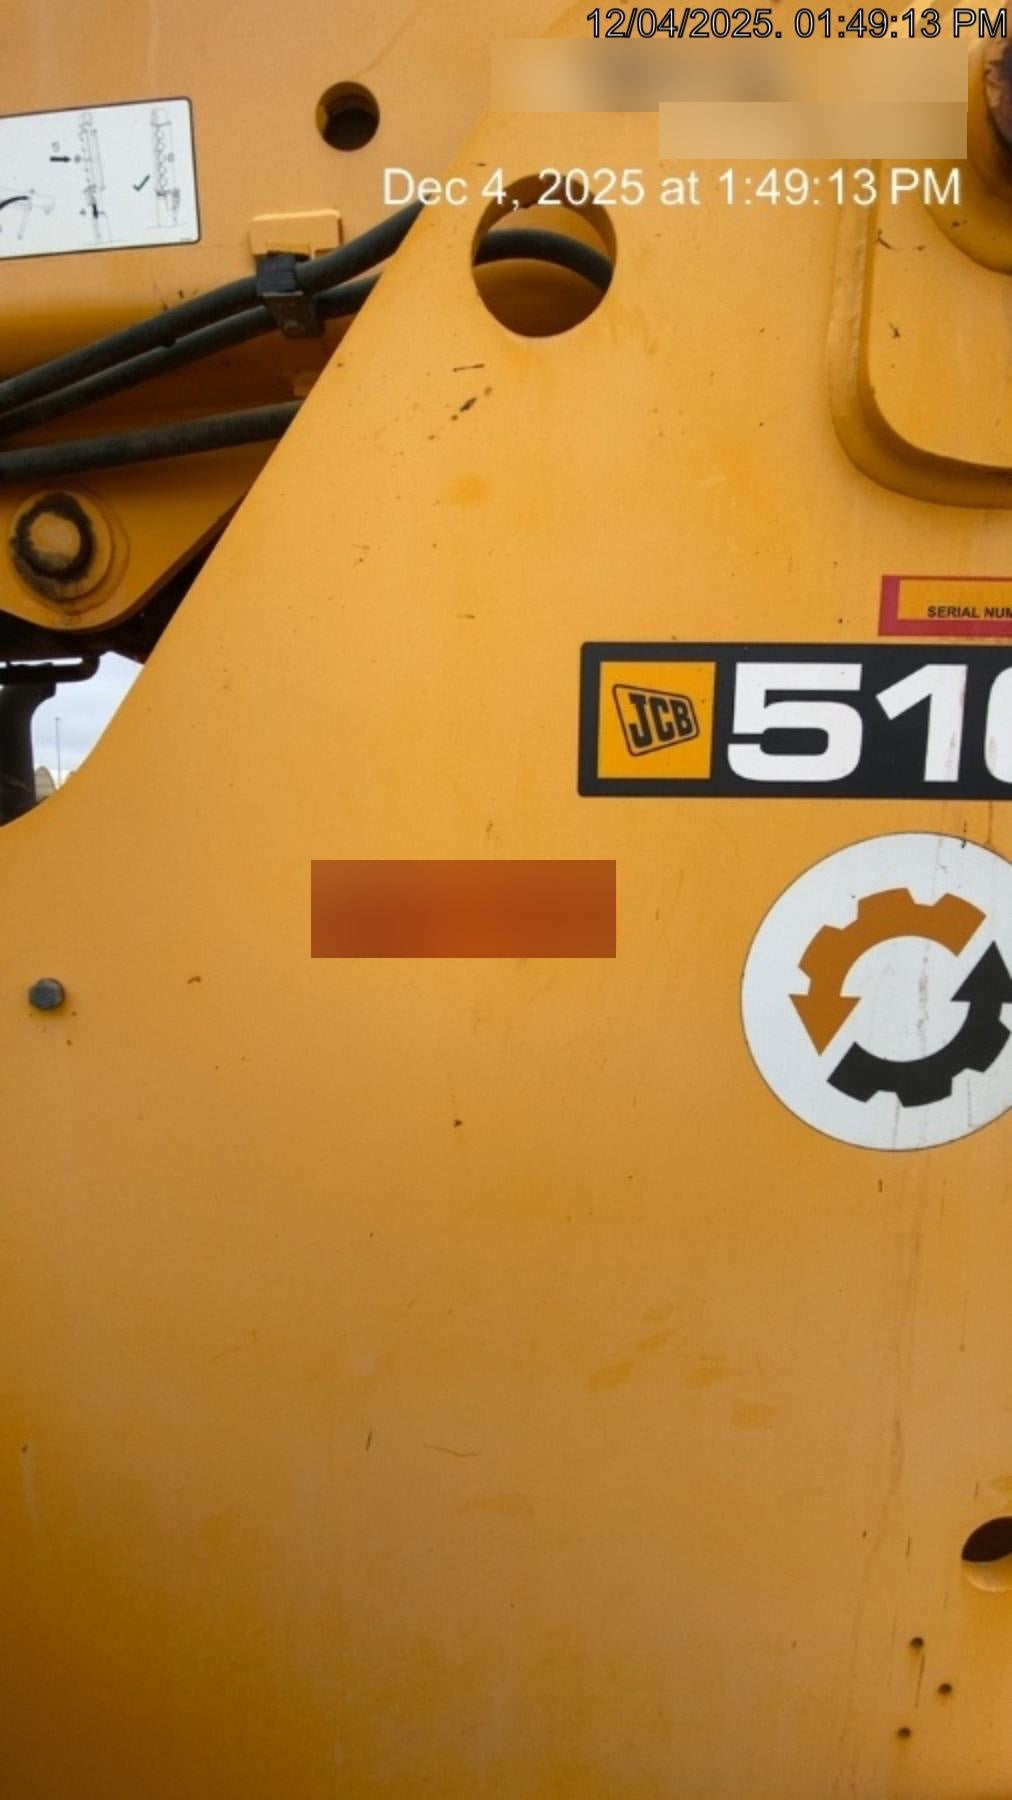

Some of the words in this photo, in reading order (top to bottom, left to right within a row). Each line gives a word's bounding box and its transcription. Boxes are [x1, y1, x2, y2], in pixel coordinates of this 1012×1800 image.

[927, 605, 979, 619] SERIAL
[628, 692, 694, 749] JCB
[727, 662, 1012, 784] 51
